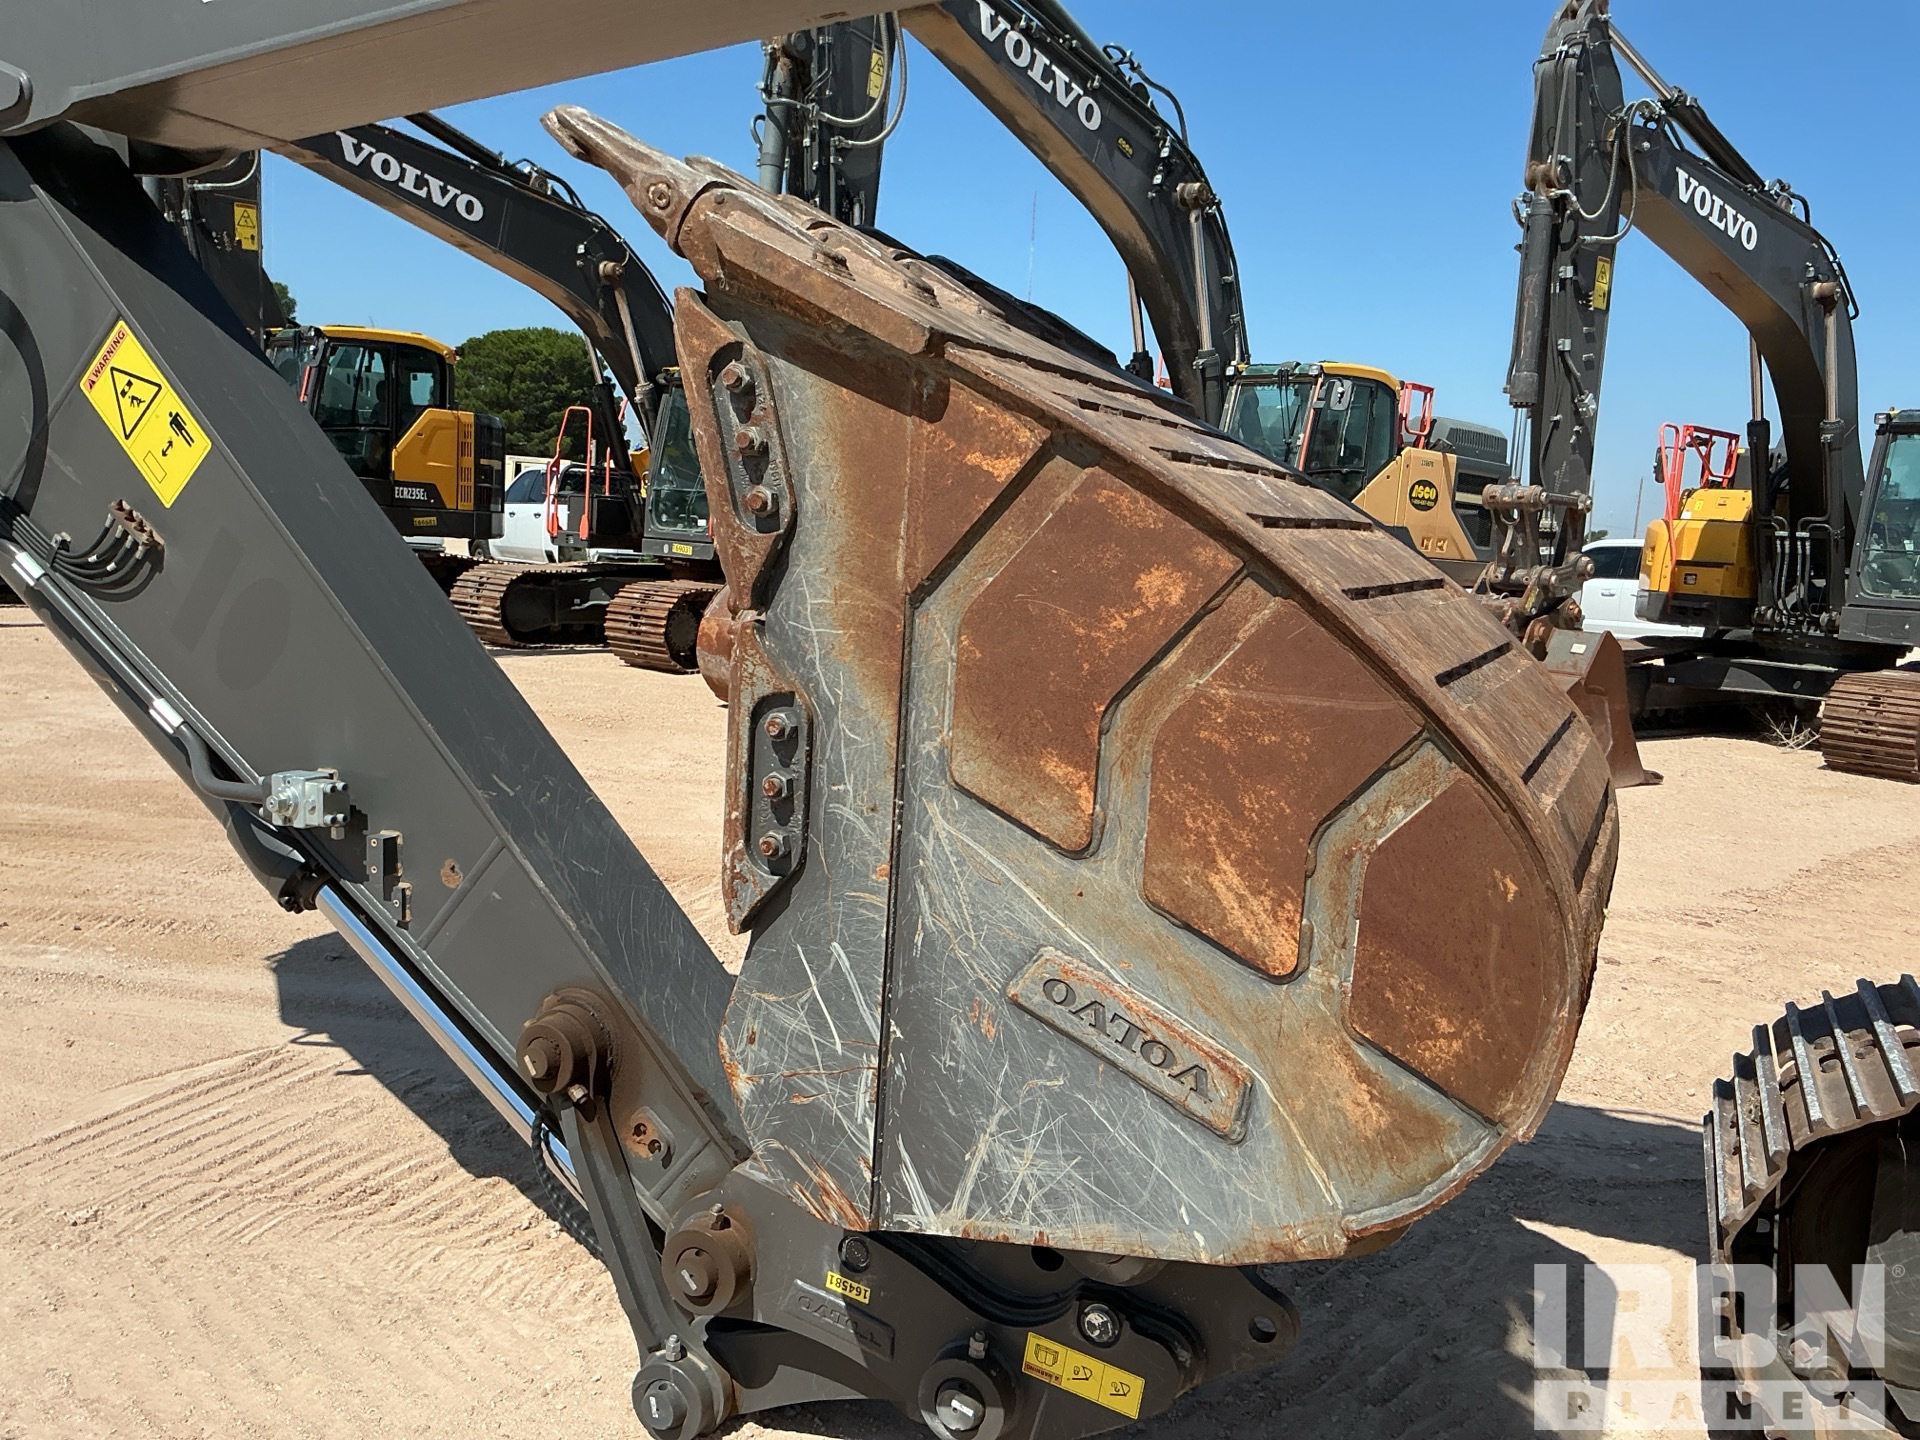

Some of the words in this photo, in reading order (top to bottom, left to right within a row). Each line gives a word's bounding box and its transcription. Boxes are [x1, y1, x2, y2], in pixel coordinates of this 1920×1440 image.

[976, 0, 1101, 131] VOLVO
[336, 131, 484, 221] VOLVO
[1676, 166, 1757, 251] VOLVO
[92, 330, 126, 379] WARNING
[1411, 484, 1436, 500] ASCO
[1042, 978, 1212, 1103] VOLVO
[829, 1274, 869, 1300] 164581
